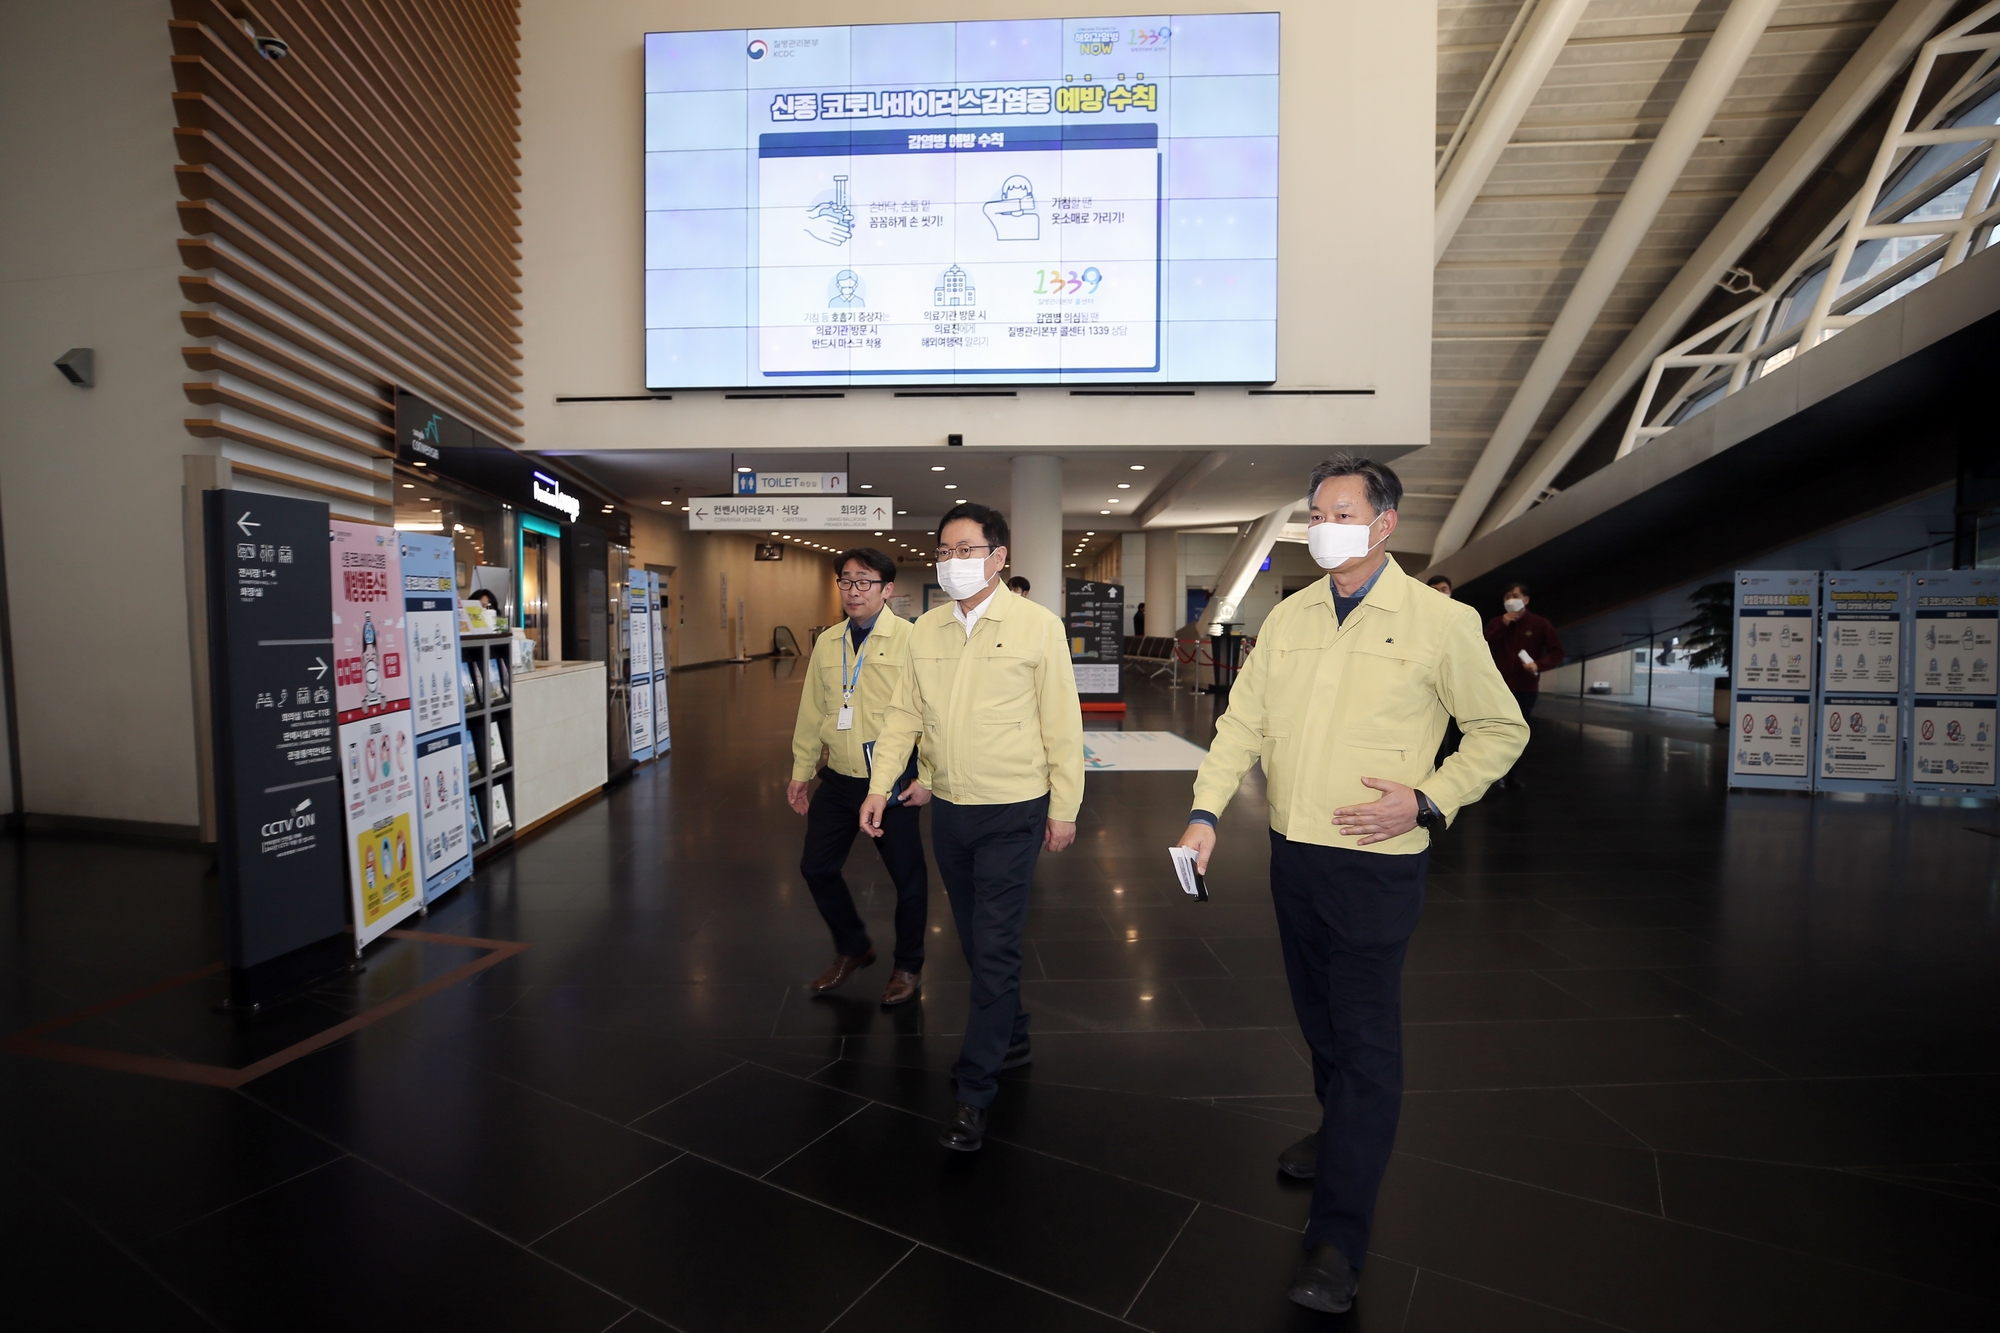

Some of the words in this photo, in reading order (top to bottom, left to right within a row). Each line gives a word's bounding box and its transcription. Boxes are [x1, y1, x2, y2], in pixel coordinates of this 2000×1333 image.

[1074, 31, 1120, 43] 해외감염병
[1127, 26, 1172, 46] 1339
[773, 38, 819, 49] 질병관리본부
[1080, 43, 1113, 56] NOW
[773, 50, 795, 58] KCDC
[771, 93, 818, 122] 신종
[821, 86, 1052, 120] 코로나바이러스감염증
[1055, 84, 1106, 113] 예방
[1108, 83, 1158, 112] 수칙
[908, 134, 947, 150] 감염병
[949, 132, 977, 149] 예방
[978, 132, 1005, 148] 수칙
[869, 200, 899, 214] 손바닥,
[901, 200, 920, 213] 손톱
[1051, 196, 1080, 210] 기침할
[1082, 196, 1093, 208] 땐
[869, 216, 907, 229] 꼼꼼하게
[909, 216, 919, 228] 손
[920, 215, 944, 228] 씻기!
[1051, 211, 1090, 225] 옷소매로
[1092, 211, 1125, 224] 가리기!
[1033, 266, 1103, 295] 1339
[803, 312, 820, 324] 기침
[821, 312, 830, 323] 등
[831, 311, 856, 323] 호흡기
[857, 311, 891, 322] 증상자는
[923, 310, 957, 321] 의료기관
[959, 310, 977, 321] 방문
[978, 310, 987, 320] 시
[1036, 312, 1062, 324] 감염병
[1064, 312, 1089, 324] 의심될
[815, 325, 848, 336] 의료기관
[850, 325, 868, 336] 방문
[869, 325, 878, 335] 시
[934, 323, 976, 334] 의료진에게
[1008, 326, 1058, 337] 질병관리본부
[1060, 326, 1086, 337] 콜센터
[1088, 326, 1110, 335] 1339
[1111, 325, 1128, 336] 상담
[812, 338, 836, 349] 반드시
[838, 338, 863, 348] 마스크
[865, 338, 882, 348] 착용
[921, 336, 963, 347] 해외여행력
[965, 336, 989, 347] 알리기
[761, 477, 799, 488] TOILET
[800, 480, 817, 488] 화장실
[713, 504, 774, 516] 컨벤시아라운지
[782, 504, 799, 515] 식당
[840, 504, 867, 516] 회의장
[238, 568, 261, 578] 전시장
[240, 587, 264, 597] 화장실
[281, 711, 302, 722] 회의실
[303, 708, 331, 719] 102-118
[261, 818, 294, 837] CCTV
[296, 813, 316, 828] ON
